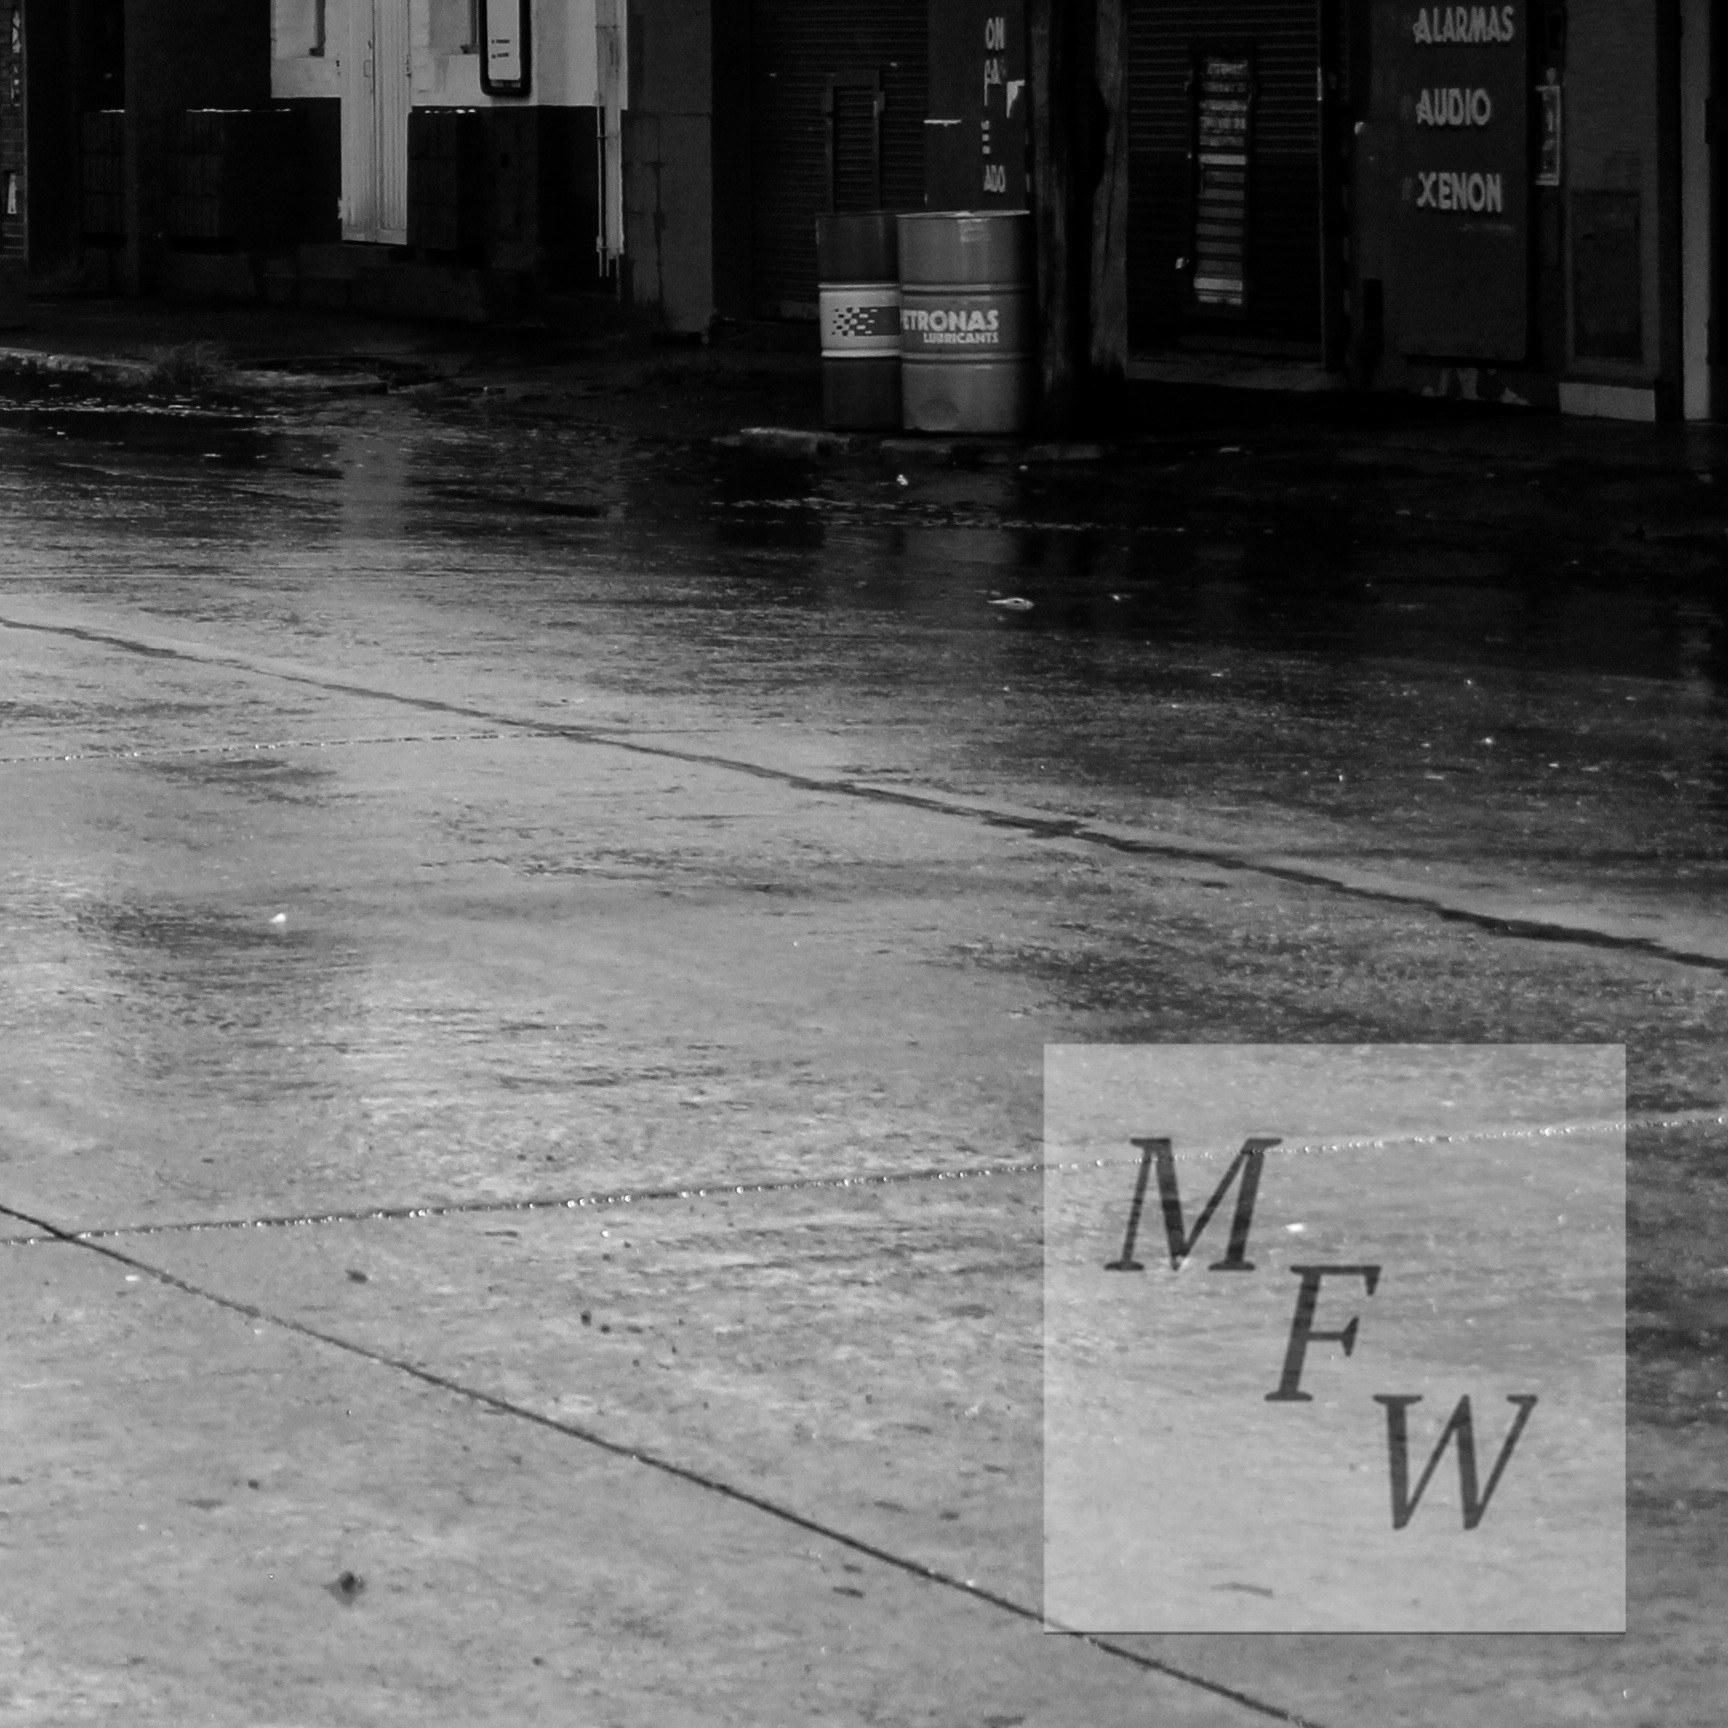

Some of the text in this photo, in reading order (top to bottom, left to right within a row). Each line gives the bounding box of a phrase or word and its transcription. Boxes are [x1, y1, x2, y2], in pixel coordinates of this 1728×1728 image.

[1412, 4, 1517, 46] ALARMAS
[1415, 86, 1494, 129] AUDIO
[1416, 171, 1504, 214] XENON
